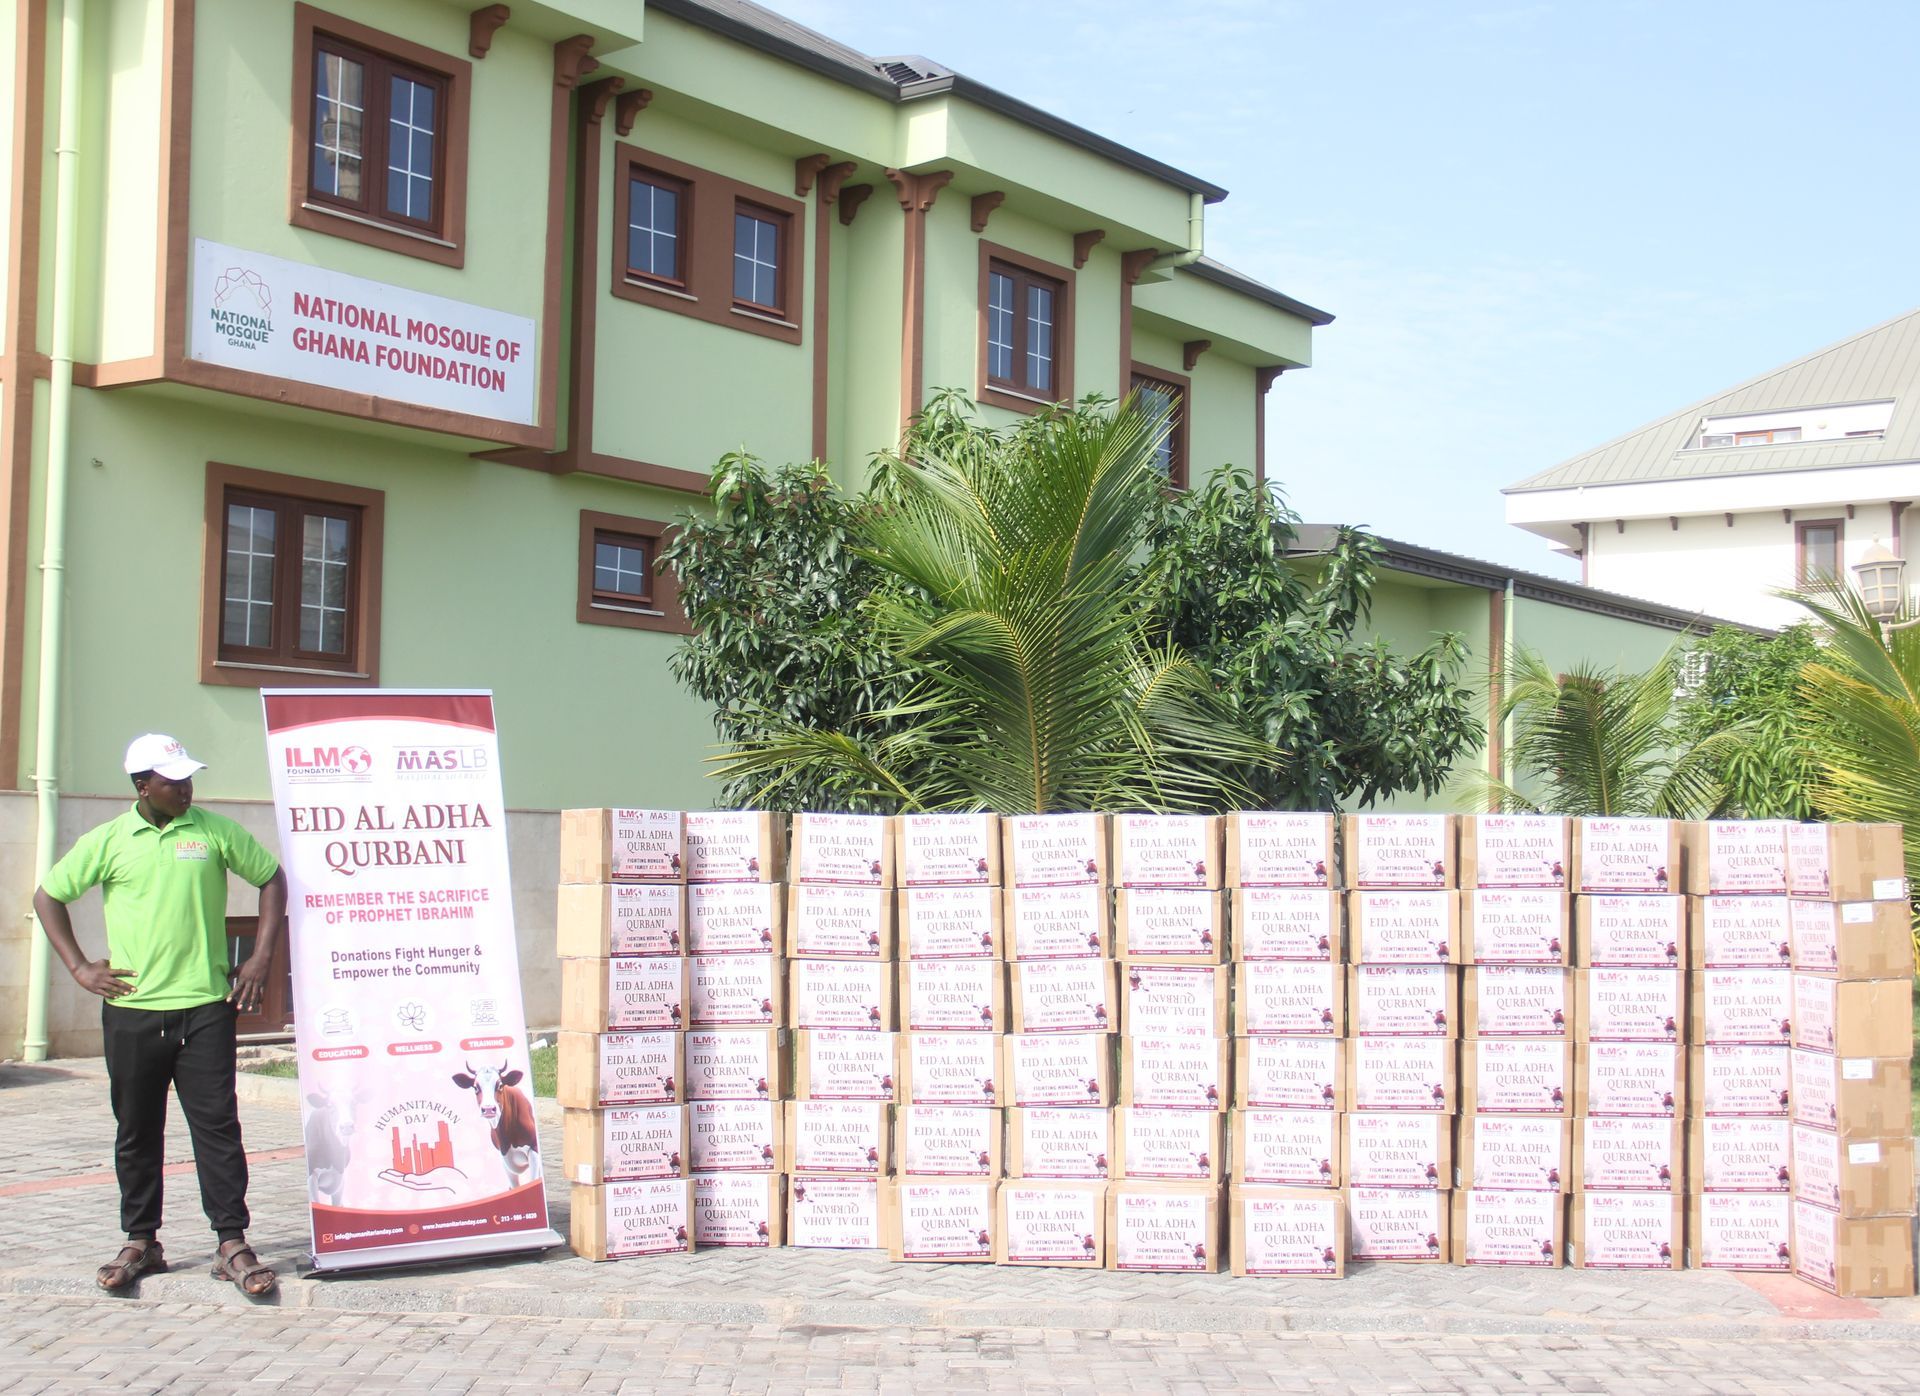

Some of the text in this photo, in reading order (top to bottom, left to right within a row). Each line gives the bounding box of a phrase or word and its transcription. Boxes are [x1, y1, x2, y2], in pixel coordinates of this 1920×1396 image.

[210, 307, 274, 333] NATIONAL
[216, 322, 269, 344] MOSQUE
[294, 292, 521, 364] NATIONAL MOSQUE OF
[228, 338, 256, 351] GHANA
[293, 328, 505, 392] GHANA FOUNDATION
[289, 804, 492, 832] EID AL ADHA
[619, 830, 673, 840] EID AL ADHA
[627, 842, 666, 854] QURBANI
[1021, 837, 1087, 849] EID AL ADHA
[1590, 842, 1658, 852] EID AL ADHA
[326, 840, 467, 875] QURBANI
[1031, 849, 1078, 863] QURBANI
[1600, 854, 1648, 867] QURBANI
[305, 888, 489, 908] REMEMBER THE SACRIFICE
[326, 906, 474, 924] OF PROPHET IBRAHIM
[618, 907, 672, 917] EID AL ADHA
[1251, 911, 1320, 921] EID AL ADHA
[626, 919, 664, 932] QURBANI
[1262, 924, 1310, 936] QURBANI
[331, 944, 482, 963] Donations Fight Hunger &
[333, 962, 481, 981] Empower the Community
[616, 981, 674, 990] EID AL ADHA
[1486, 986, 1554, 995] EID AL ADHA
[624, 993, 666, 1006] QURBANI
[1496, 998, 1545, 1011] QURBANI
[395, 1044, 433, 1052] WELLNESS
[468, 1038, 504, 1048] TRAINING
[318, 1049, 362, 1058] EDUCATION
[607, 1054, 667, 1065] EID AL ADHA
[694, 1055, 758, 1064] EID AL ADHA
[616, 1066, 658, 1080] QURBANI
[703, 1067, 749, 1079] QURBANI
[375, 1100, 461, 1131] HUMANITARIAN
[405, 1114, 429, 1125] DAY
[698, 1122, 763, 1132] EID AL ADHA
[612, 1129, 673, 1141] EID AL ADHA
[708, 1134, 754, 1147] QURBANI
[620, 1142, 664, 1156] QURBANI
[614, 1203, 678, 1217] EID AL ADHA
[812, 1202, 859, 1214] QURBANI
[910, 1206, 979, 1217] EID AL ADHA
[1359, 1210, 1428, 1219] EID AL ADHA
[422, 1217, 487, 1230] www.humanitarianday.com
[624, 1215, 669, 1231] QURBANI
[803, 1216, 869, 1226] EID AL ADHA
[921, 1218, 970, 1232] QURBANI
[1126, 1218, 1196, 1228] EID AL ADHA
[1254, 1222, 1325, 1232] EID AL ADHA
[1710, 1218, 1779, 1228] EID AL ADHA
[1370, 1222, 1419, 1234] QURBANI
[1136, 1231, 1186, 1243] QURBANI
[1264, 1235, 1315, 1248] QURBANI
[1720, 1230, 1769, 1242] QURBANI
